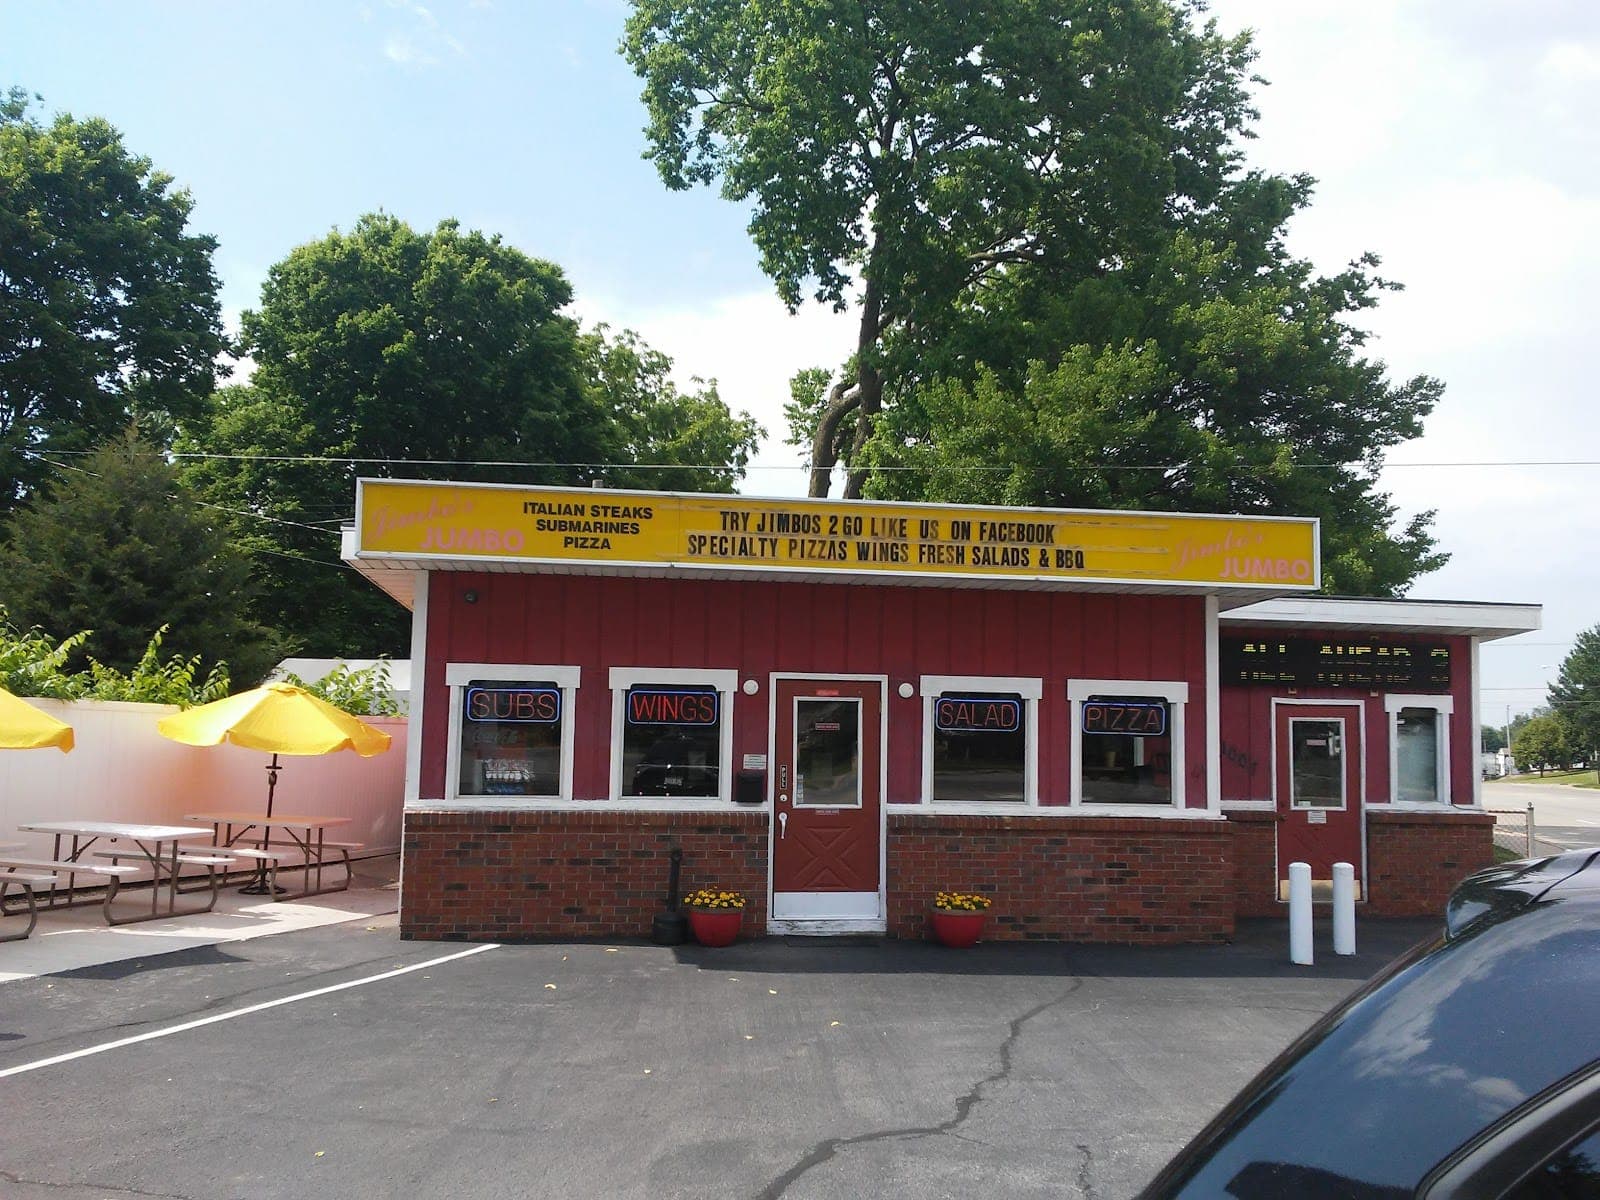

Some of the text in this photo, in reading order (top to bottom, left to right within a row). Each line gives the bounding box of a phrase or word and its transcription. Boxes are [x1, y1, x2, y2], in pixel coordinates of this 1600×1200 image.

[523, 502, 653, 519] ITALIAN STEAKS
[536, 519, 640, 534] SUBMARINES
[720, 511, 1056, 544] TRY JIMBOS 2 GO LIKE US ON FACEBOOK
[420, 527, 525, 552] JUMBO
[563, 536, 611, 550] PIZZA
[688, 534, 1085, 569] SPECIALTY PIZZAS WINGS FRESH SALADS & BBQ
[1219, 557, 1310, 580] JUMBO
[473, 692, 555, 719] SUBS
[632, 695, 714, 722] WINGS
[940, 703, 1015, 728] SALAD
[1087, 707, 1161, 731] PIZZA
